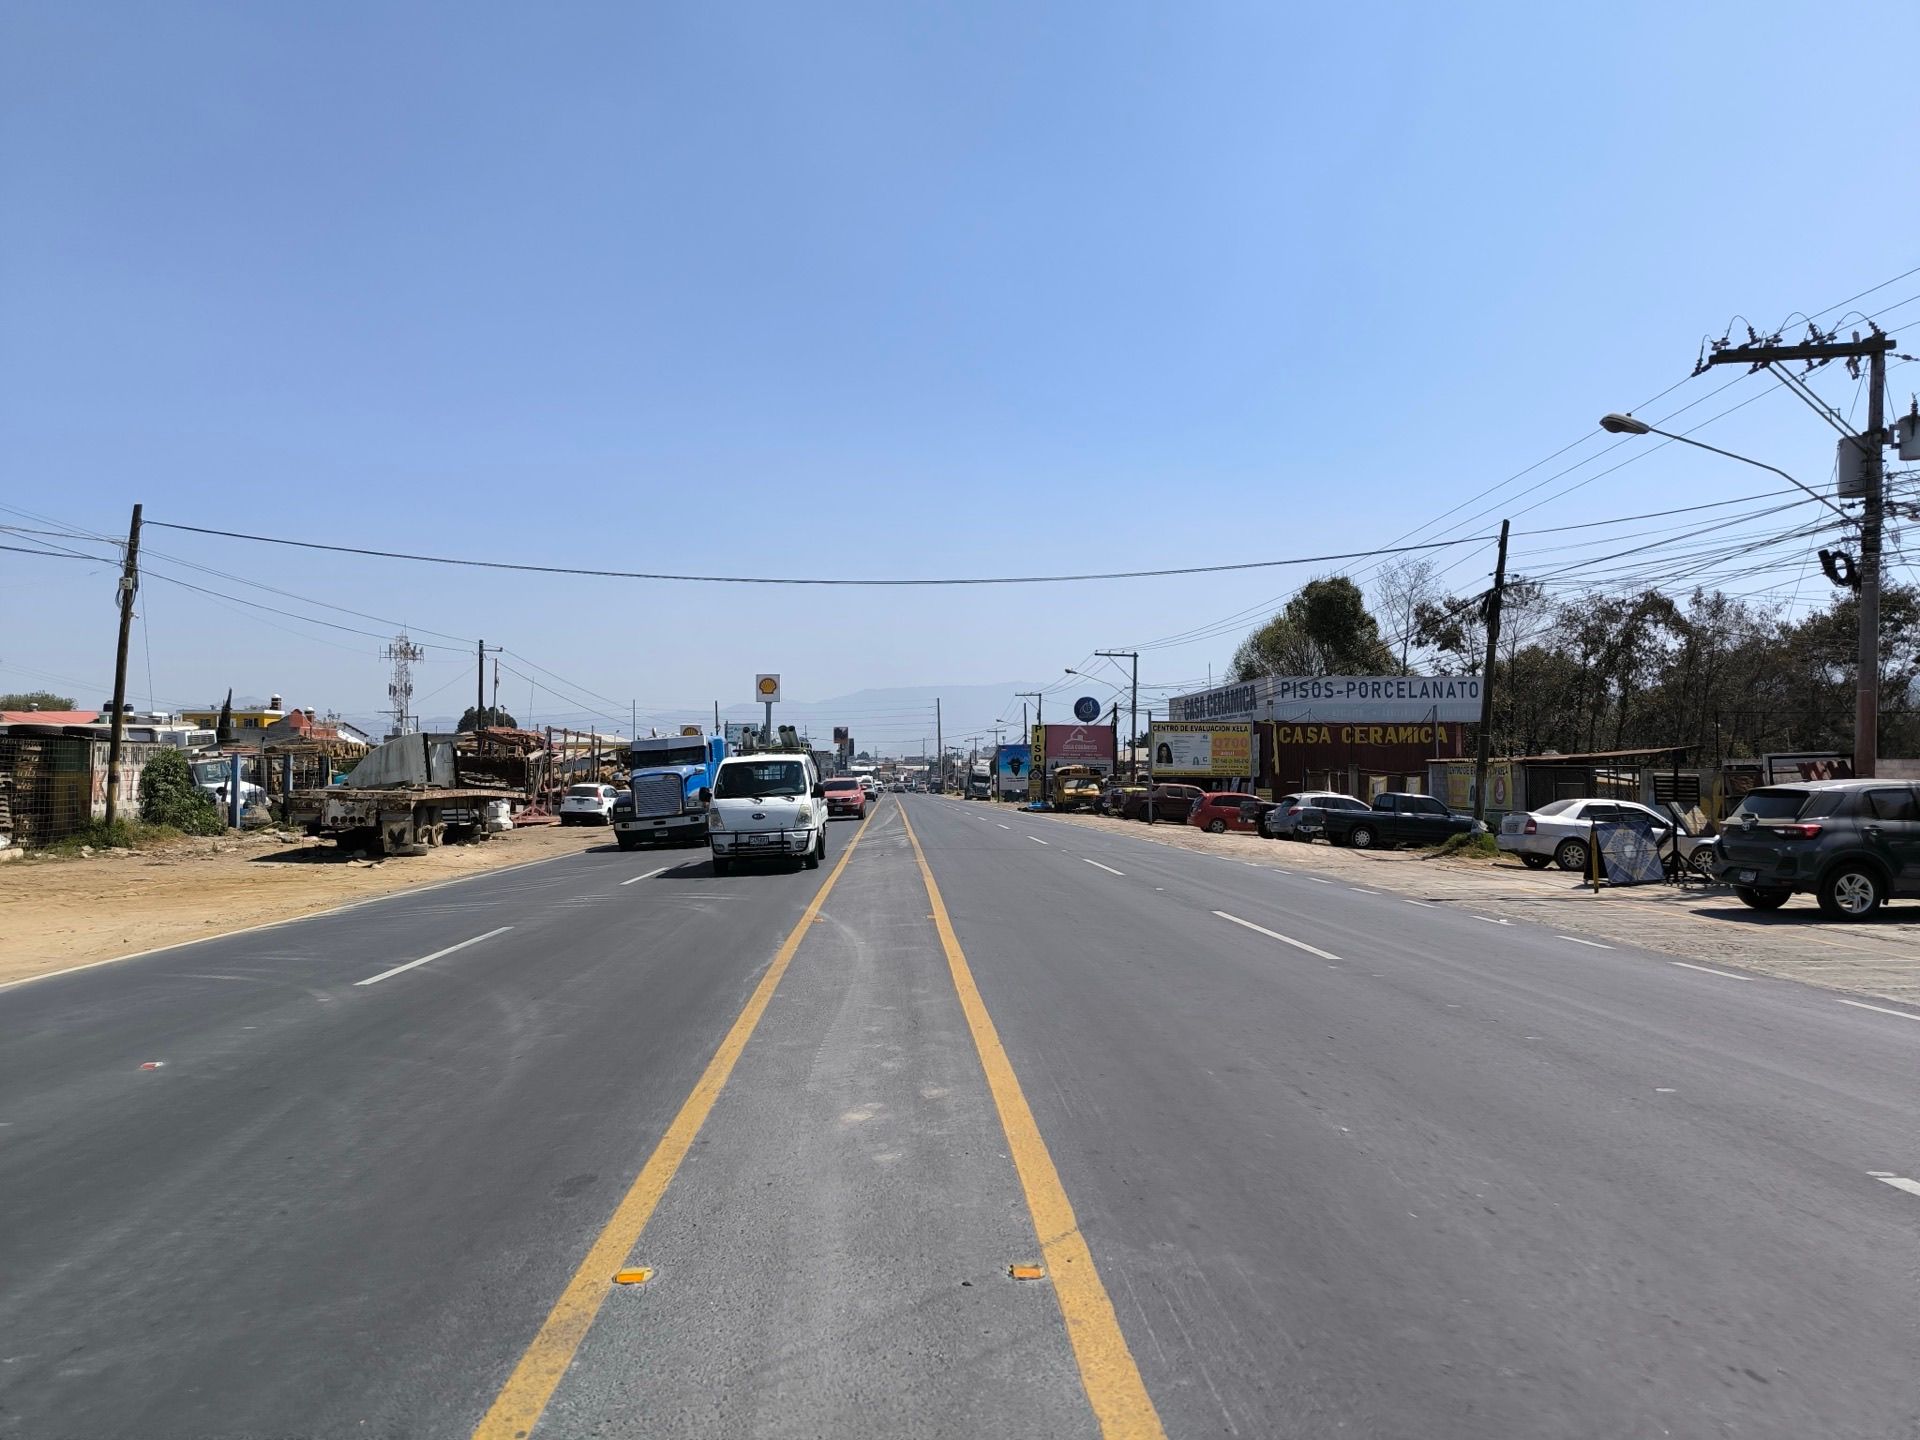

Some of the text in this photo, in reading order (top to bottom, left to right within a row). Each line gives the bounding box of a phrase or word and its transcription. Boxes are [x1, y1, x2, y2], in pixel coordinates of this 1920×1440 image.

[1280, 681, 1480, 699] PISOS-PORCELANATO
[1184, 696, 1206, 720] CASA
[1152, 724, 1179, 733] CENTRO
[1180, 724, 1189, 732] DE
[1232, 725, 1249, 733] XELA
[1279, 726, 1331, 744] CASA
